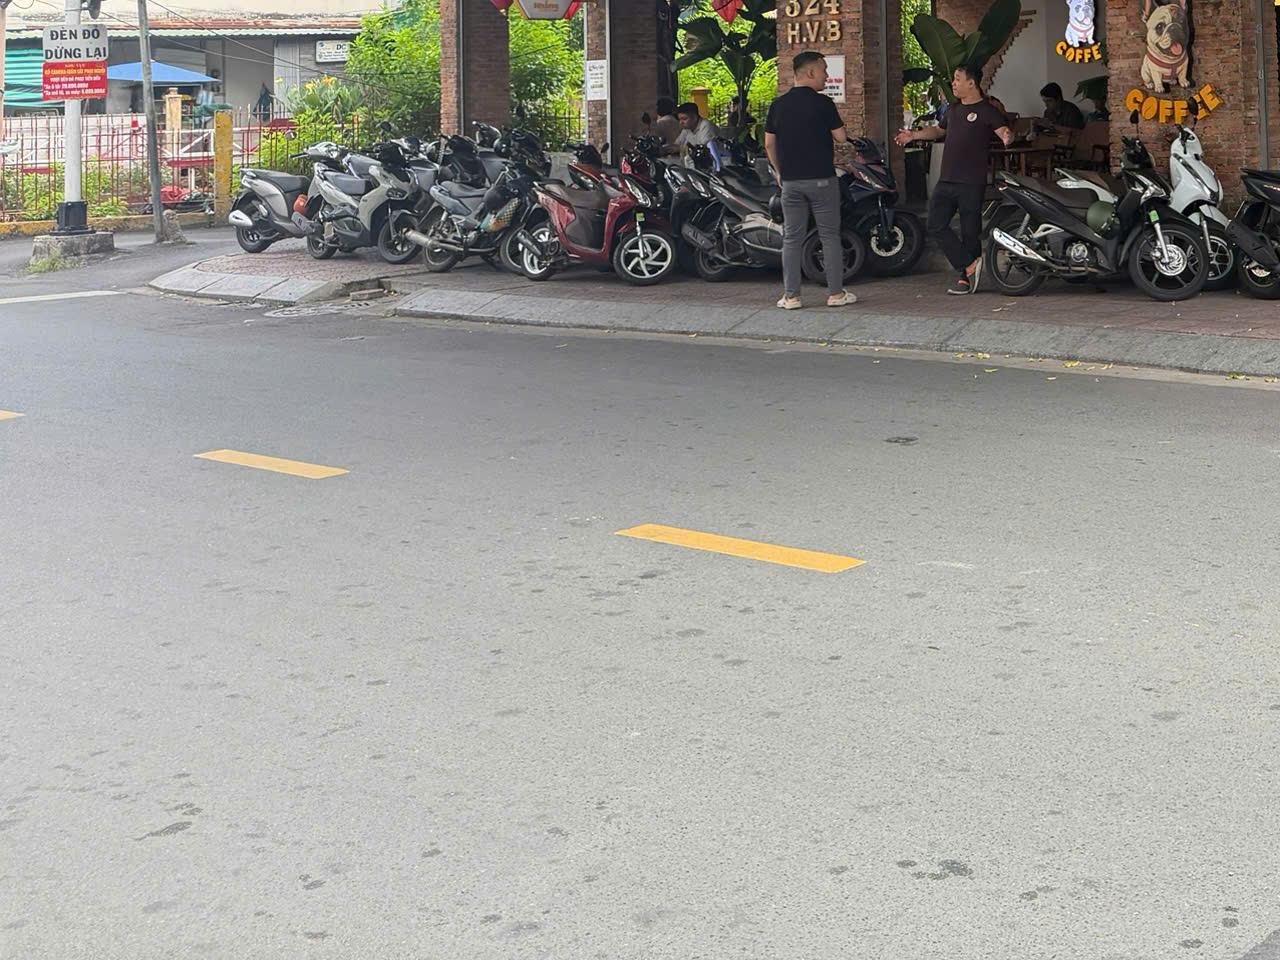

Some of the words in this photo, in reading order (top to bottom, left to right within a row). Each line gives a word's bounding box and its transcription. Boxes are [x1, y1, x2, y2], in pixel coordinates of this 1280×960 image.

[50, 26, 78, 41] ĐÈN
[82, 24, 101, 40] ĐỎ
[786, 20, 841, 44] H.V.B
[44, 46, 82, 60] DỪNG
[86, 47, 107, 60] LẠI
[1126, 83, 1222, 124] COFFEE
